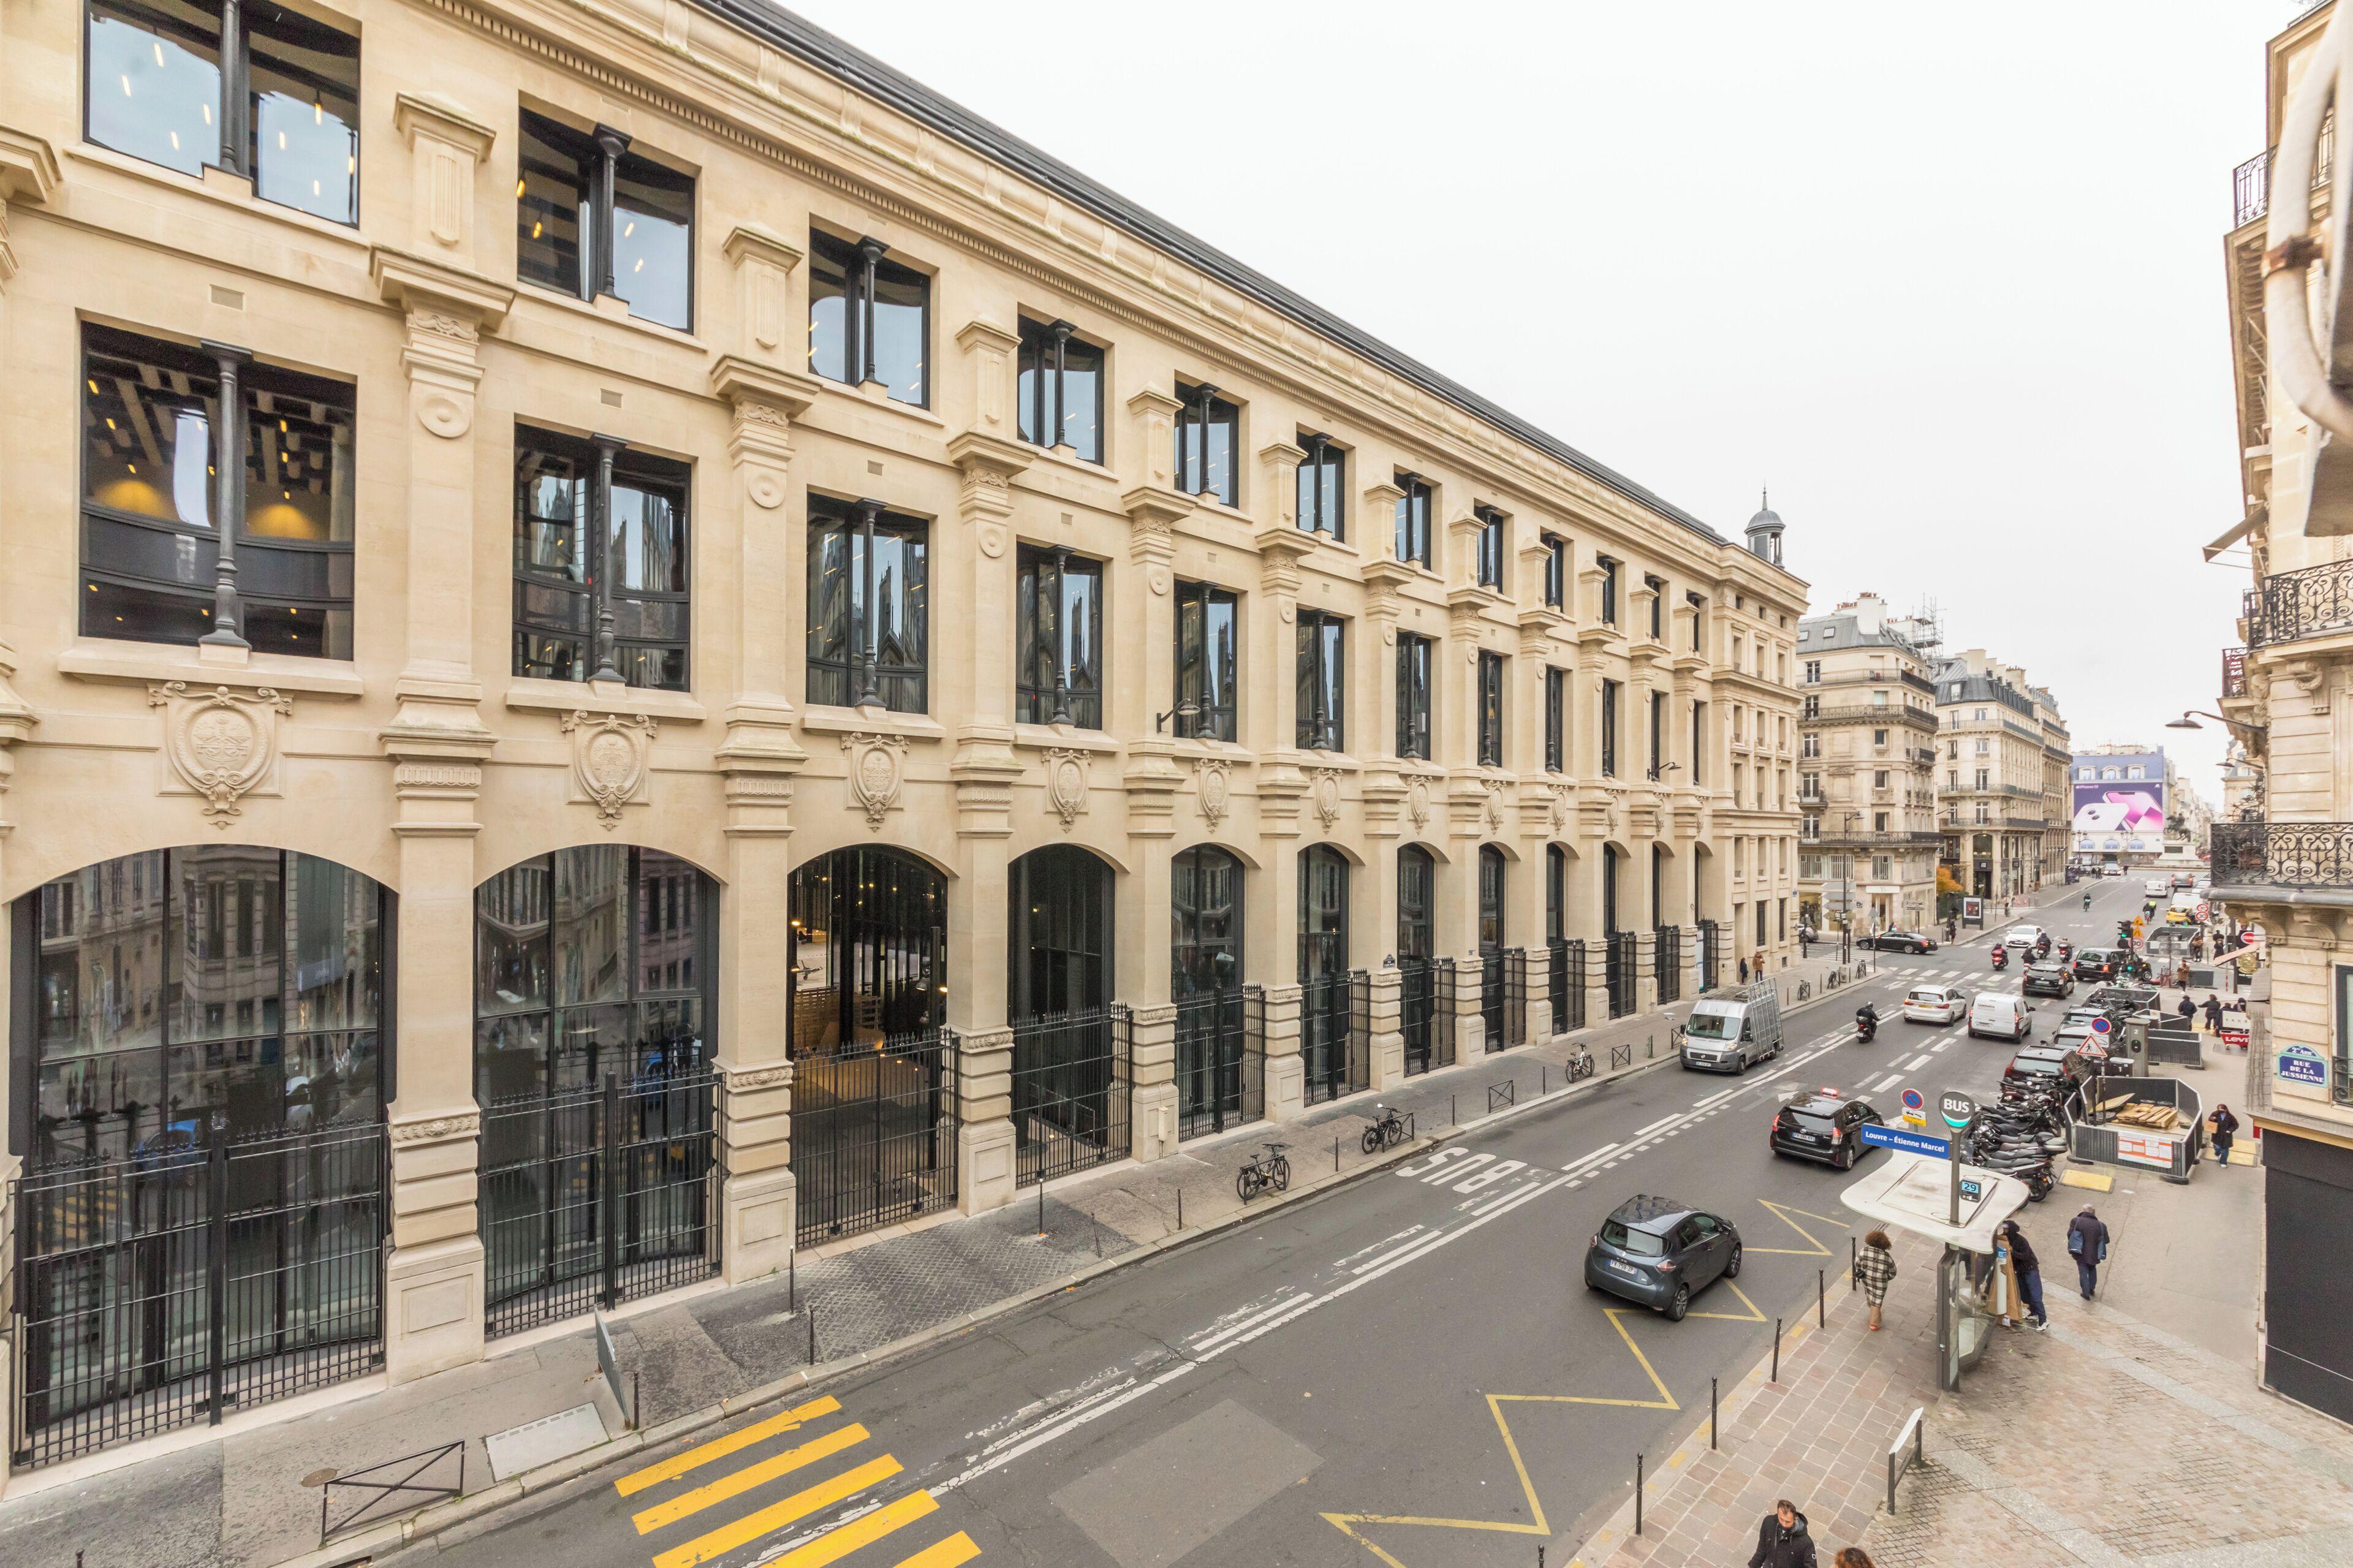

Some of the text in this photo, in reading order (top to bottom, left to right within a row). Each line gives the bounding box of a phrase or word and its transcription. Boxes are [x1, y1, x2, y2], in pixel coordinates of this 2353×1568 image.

[2281, 1070, 2324, 1083] JUSSIENNE
[1944, 1098, 1969, 1113] BUS
[1865, 1131, 1887, 1141] Louvre
[1894, 1135, 1920, 1148] Étienne
[1921, 1142, 1944, 1153] Marcel
[1395, 1147, 1528, 1194] BUS
[1964, 1183, 1977, 1192] 29
